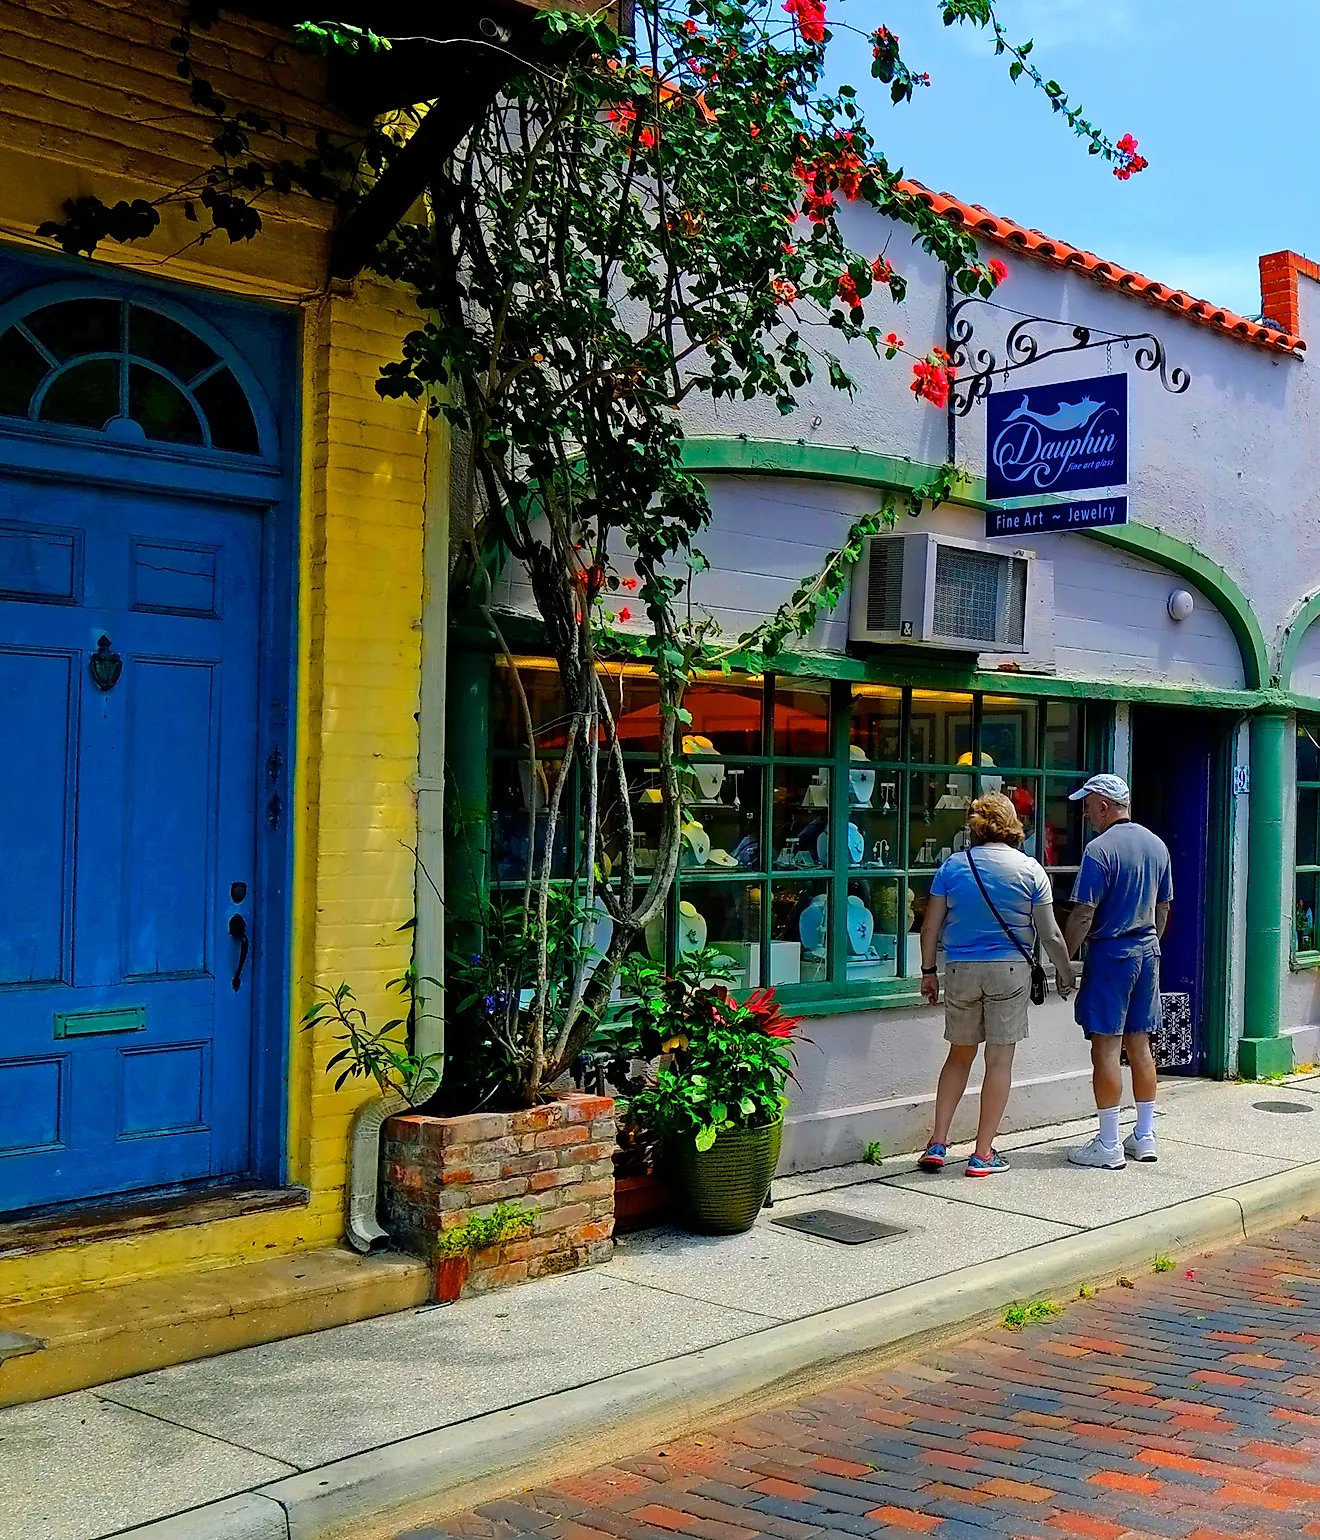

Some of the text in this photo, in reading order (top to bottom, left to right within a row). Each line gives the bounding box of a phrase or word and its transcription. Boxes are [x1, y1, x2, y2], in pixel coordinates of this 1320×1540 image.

[993, 408, 1119, 487] Dauphin
[1066, 459, 1115, 473] fine art glass
[996, 514, 1020, 529] Fine
[1024, 511, 1043, 527] Art
[1068, 504, 1115, 523] Jewelry
[904, 622, 912, 636] &
[1239, 770, 1246, 787] 9
